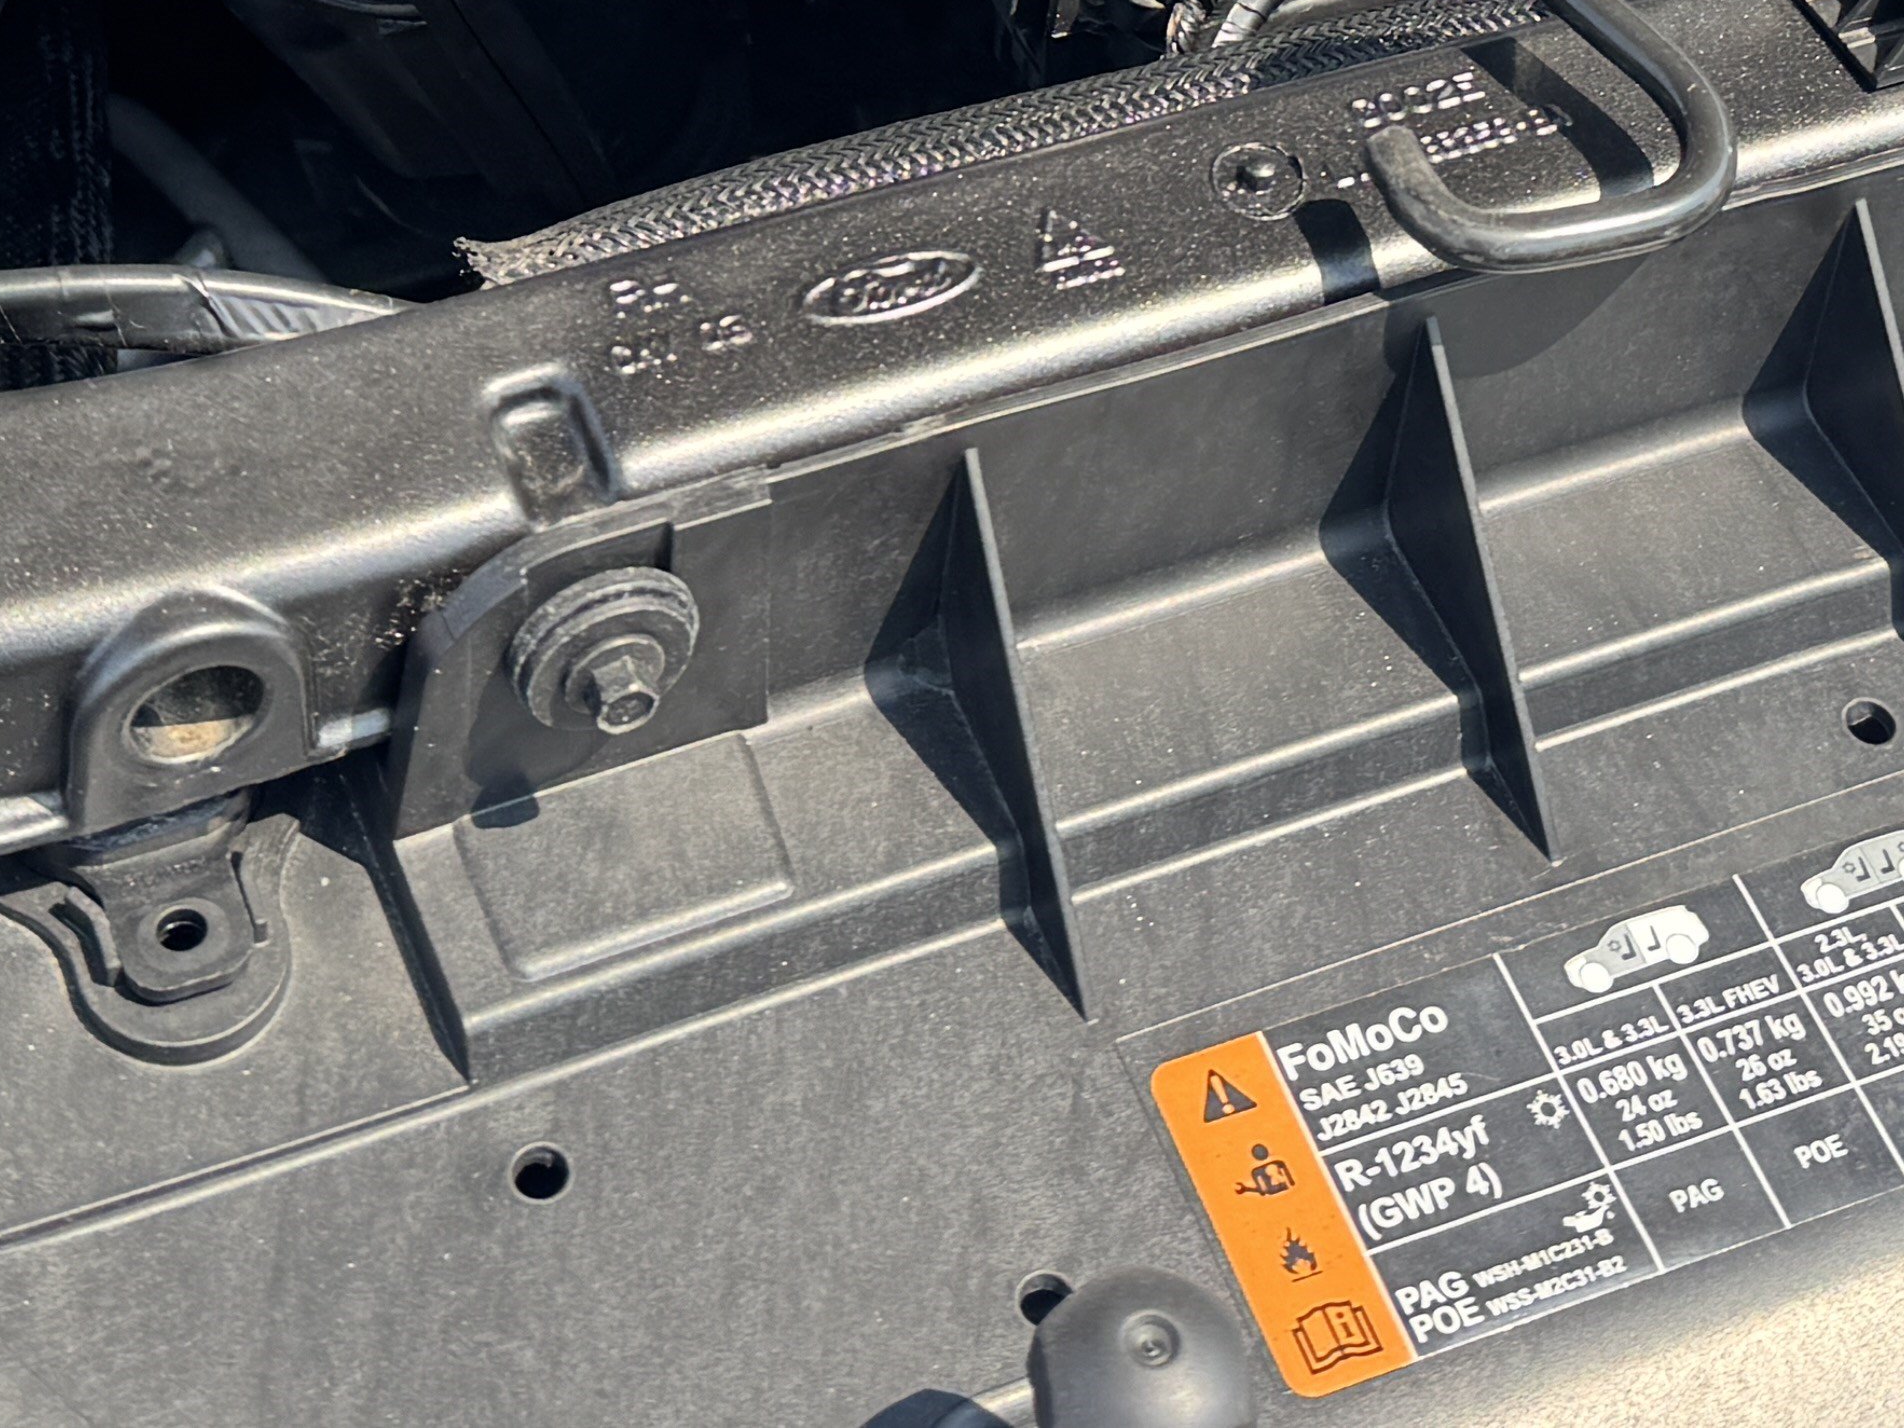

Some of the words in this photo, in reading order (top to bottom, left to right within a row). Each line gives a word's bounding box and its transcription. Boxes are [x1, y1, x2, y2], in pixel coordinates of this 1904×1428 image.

[1813, 925, 1869, 955] 2.3L,
[1796, 955, 1845, 984] 3.0L
[1842, 947, 1864, 970] &
[1675, 995, 1726, 1024] 3.3L
[1722, 973, 1781, 1010] FHEV
[1822, 974, 1896, 1019] 0.992
[1276, 1005, 1449, 1082] FoMoCo
[1552, 1036, 1604, 1066] 3.0L
[1601, 1028, 1623, 1050] &
[1620, 1015, 1670, 1044] 3.3L
[1696, 1019, 1765, 1063] 0.737
[1764, 1012, 1807, 1042] kg
[1861, 1008, 1894, 1037] 35
[1298, 1074, 1362, 1112] SAE
[1363, 1053, 1426, 1093] J639
[1576, 1059, 1649, 1104] 0.680
[1645, 1052, 1689, 1083] kg
[1735, 1053, 1768, 1082] 26
[1767, 1048, 1798, 1071] oz
[1316, 1100, 1393, 1142] J2842
[1395, 1071, 1469, 1116] J2845
[1615, 1093, 1647, 1123] 24
[1647, 1088, 1679, 1113] oz
[1738, 1081, 1789, 1110] 1.63
[1783, 1069, 1824, 1096] lbs
[1334, 1114, 1491, 1193] R-1234yf
[1617, 1119, 1667, 1152] 1.50
[1663, 1110, 1704, 1138] lbs
[1793, 1133, 1850, 1170] POE
[1357, 1176, 1457, 1241] (GWP
[1465, 1161, 1503, 1199] 4)
[1668, 1178, 1725, 1214] PAG
[1395, 1270, 1471, 1316] PAG
[1408, 1295, 1487, 1344] POE
